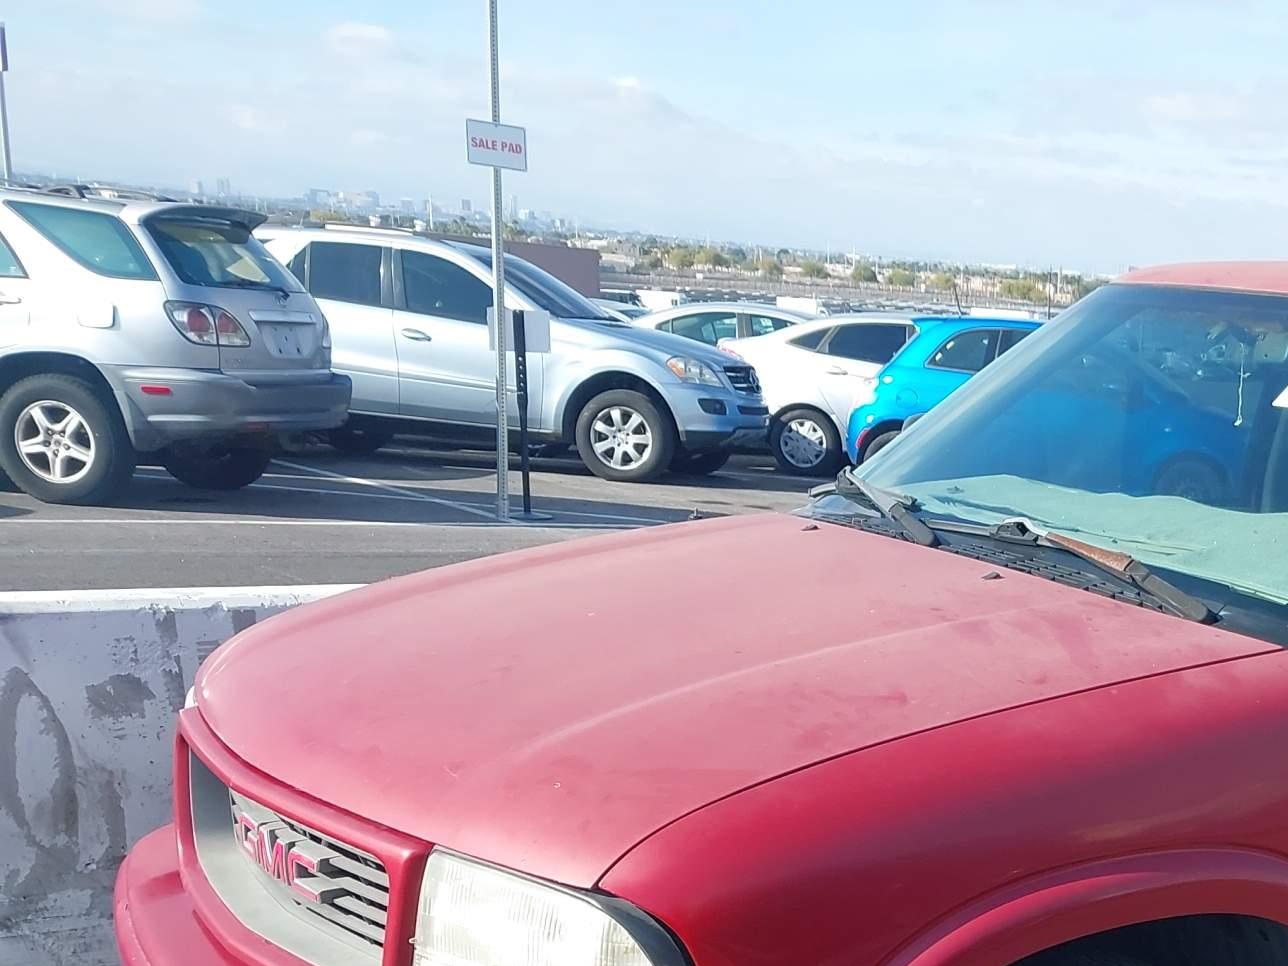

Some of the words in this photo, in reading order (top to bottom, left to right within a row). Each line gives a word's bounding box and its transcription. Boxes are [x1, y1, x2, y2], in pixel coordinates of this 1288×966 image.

[471, 136, 498, 151] SALE
[501, 141, 522, 155] PAD
[239, 811, 320, 903] GMC
